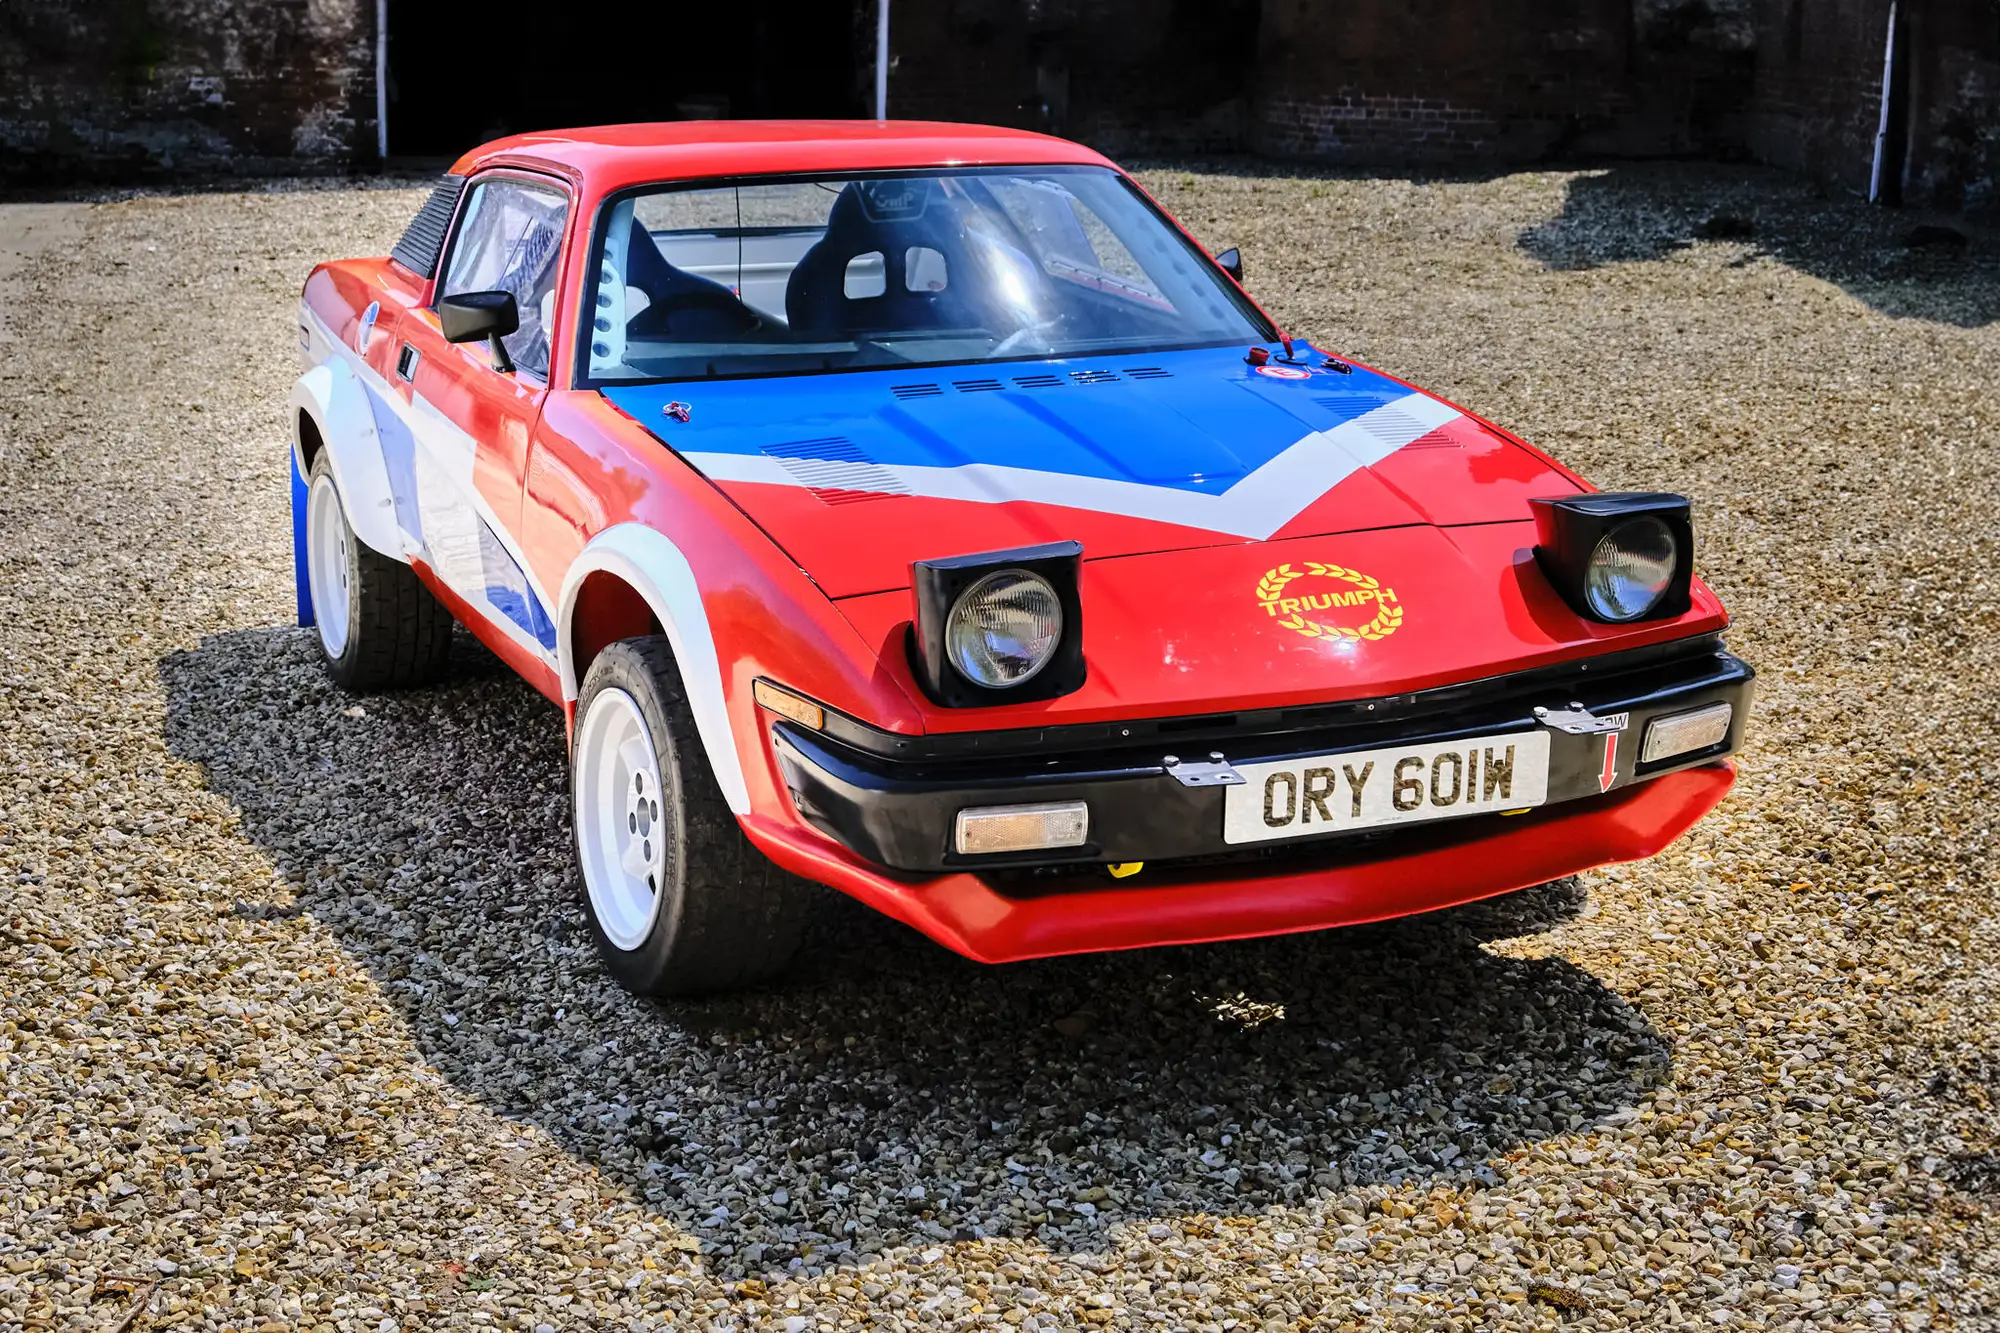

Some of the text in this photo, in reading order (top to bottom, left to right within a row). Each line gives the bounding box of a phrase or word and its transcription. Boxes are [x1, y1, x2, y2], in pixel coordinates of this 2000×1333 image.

[1258, 588, 1398, 616] TRIUMPH
[1263, 745, 1515, 827] ORY 601W
